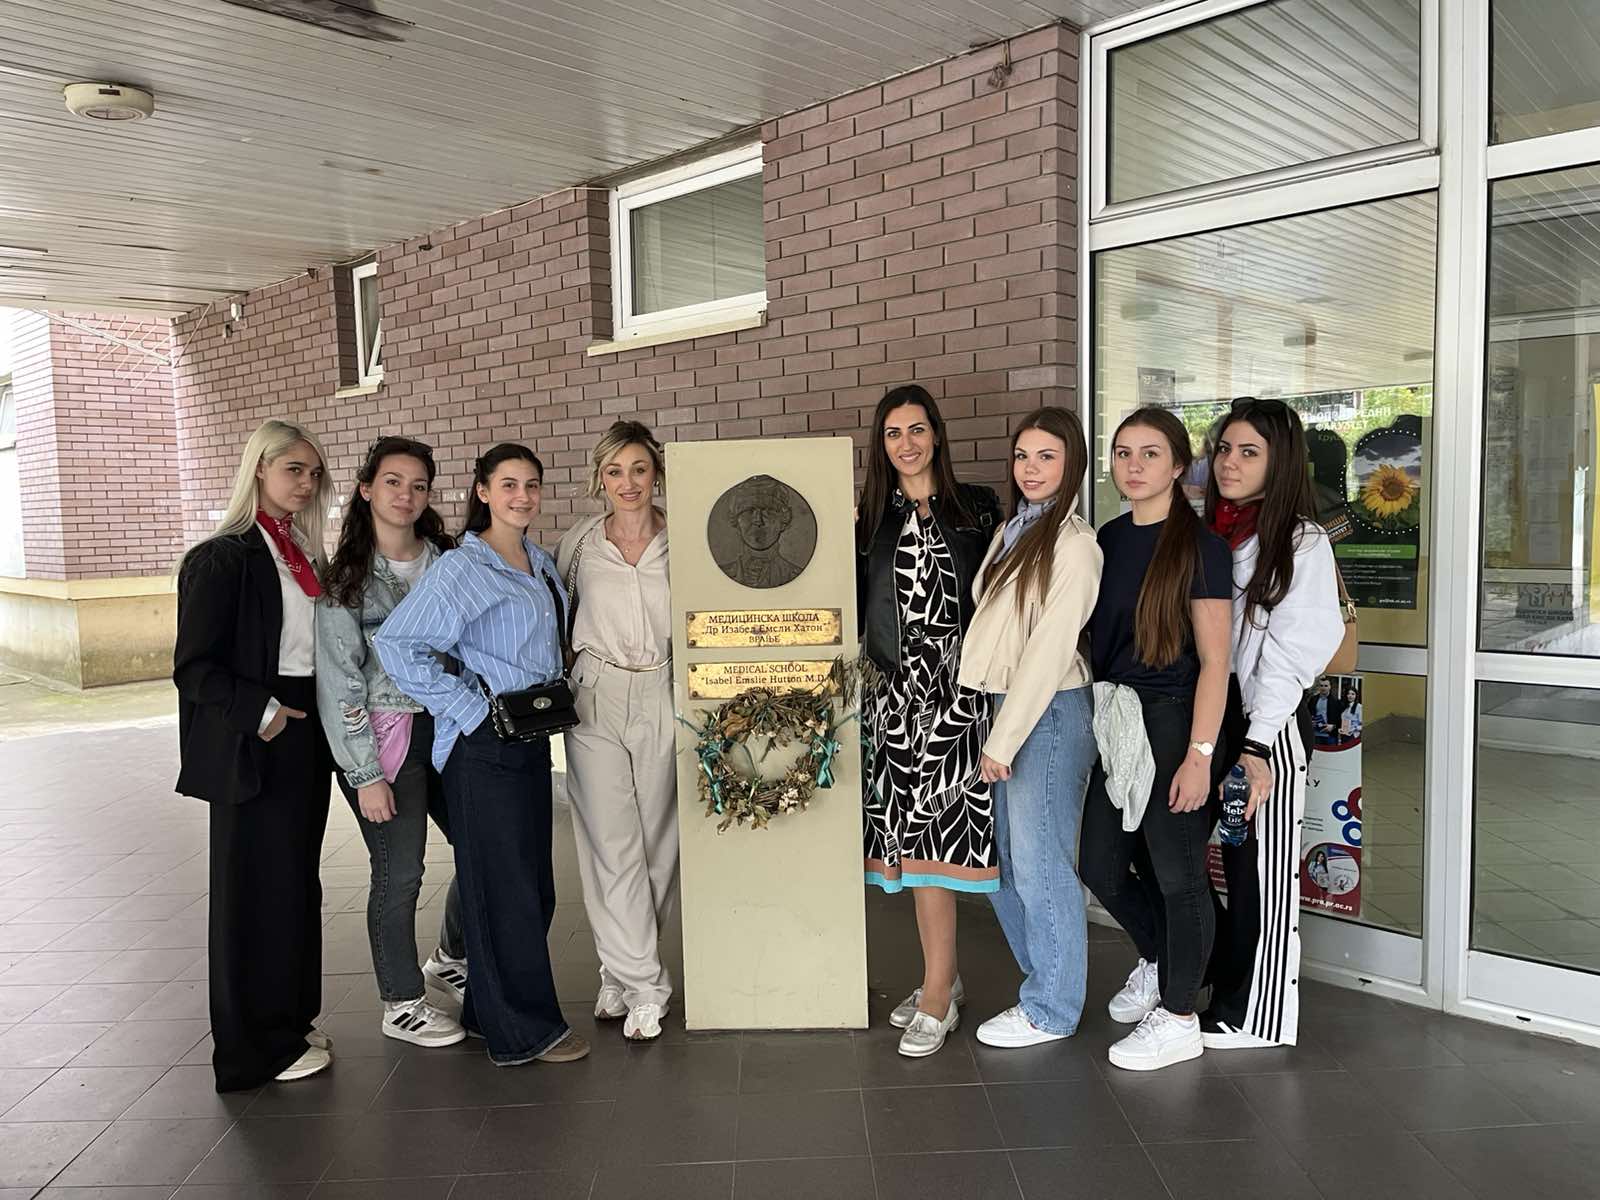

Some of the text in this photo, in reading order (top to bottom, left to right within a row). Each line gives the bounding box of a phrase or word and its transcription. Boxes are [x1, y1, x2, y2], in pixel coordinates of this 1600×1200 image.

[708, 612, 819, 624] МЕДИЦИНСКА ШКОЛА
[721, 624, 756, 634] Изабел
[759, 624, 791, 633] Емсли
[723, 663, 808, 674] MEDICAL SCHOOL
[735, 675, 767, 685] Emslie
[770, 674, 802, 684] Hutton
